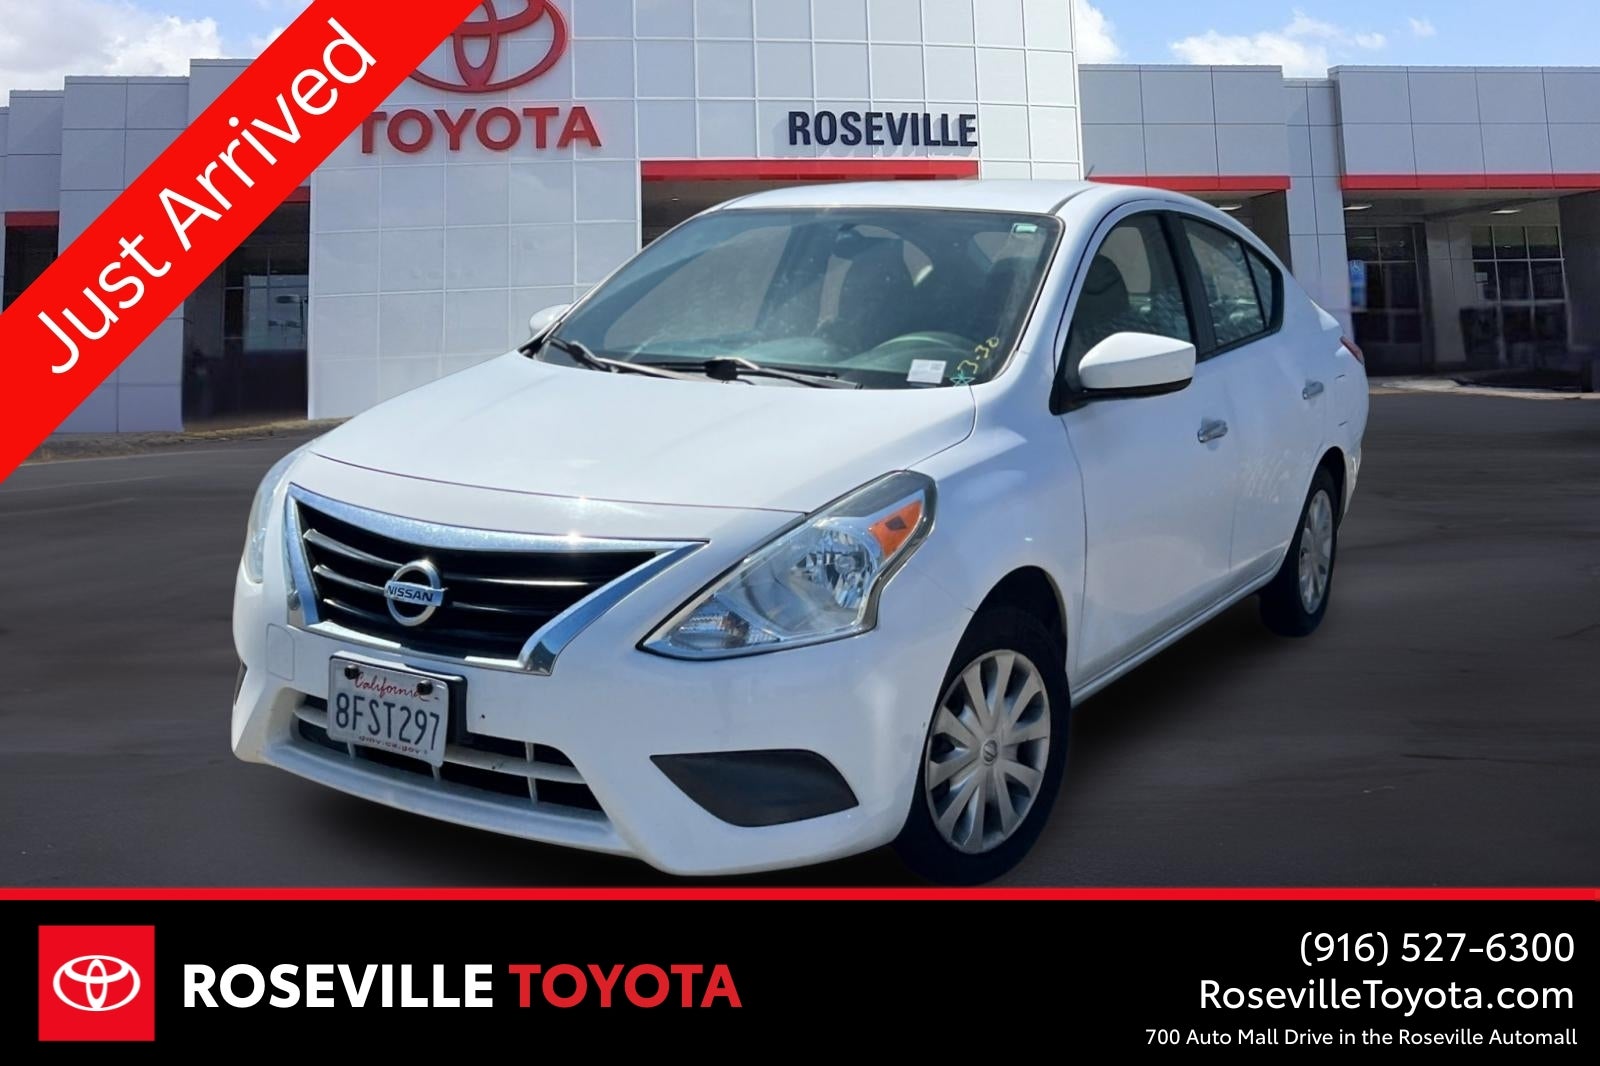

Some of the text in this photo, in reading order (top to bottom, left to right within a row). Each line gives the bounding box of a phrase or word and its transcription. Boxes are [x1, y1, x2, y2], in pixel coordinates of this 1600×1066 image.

[362, 106, 602, 154] TOYOTA
[788, 111, 978, 147] ROSEVILLE
[387, 584, 434, 602] NISSAN
[335, 692, 440, 751] 8FST297
